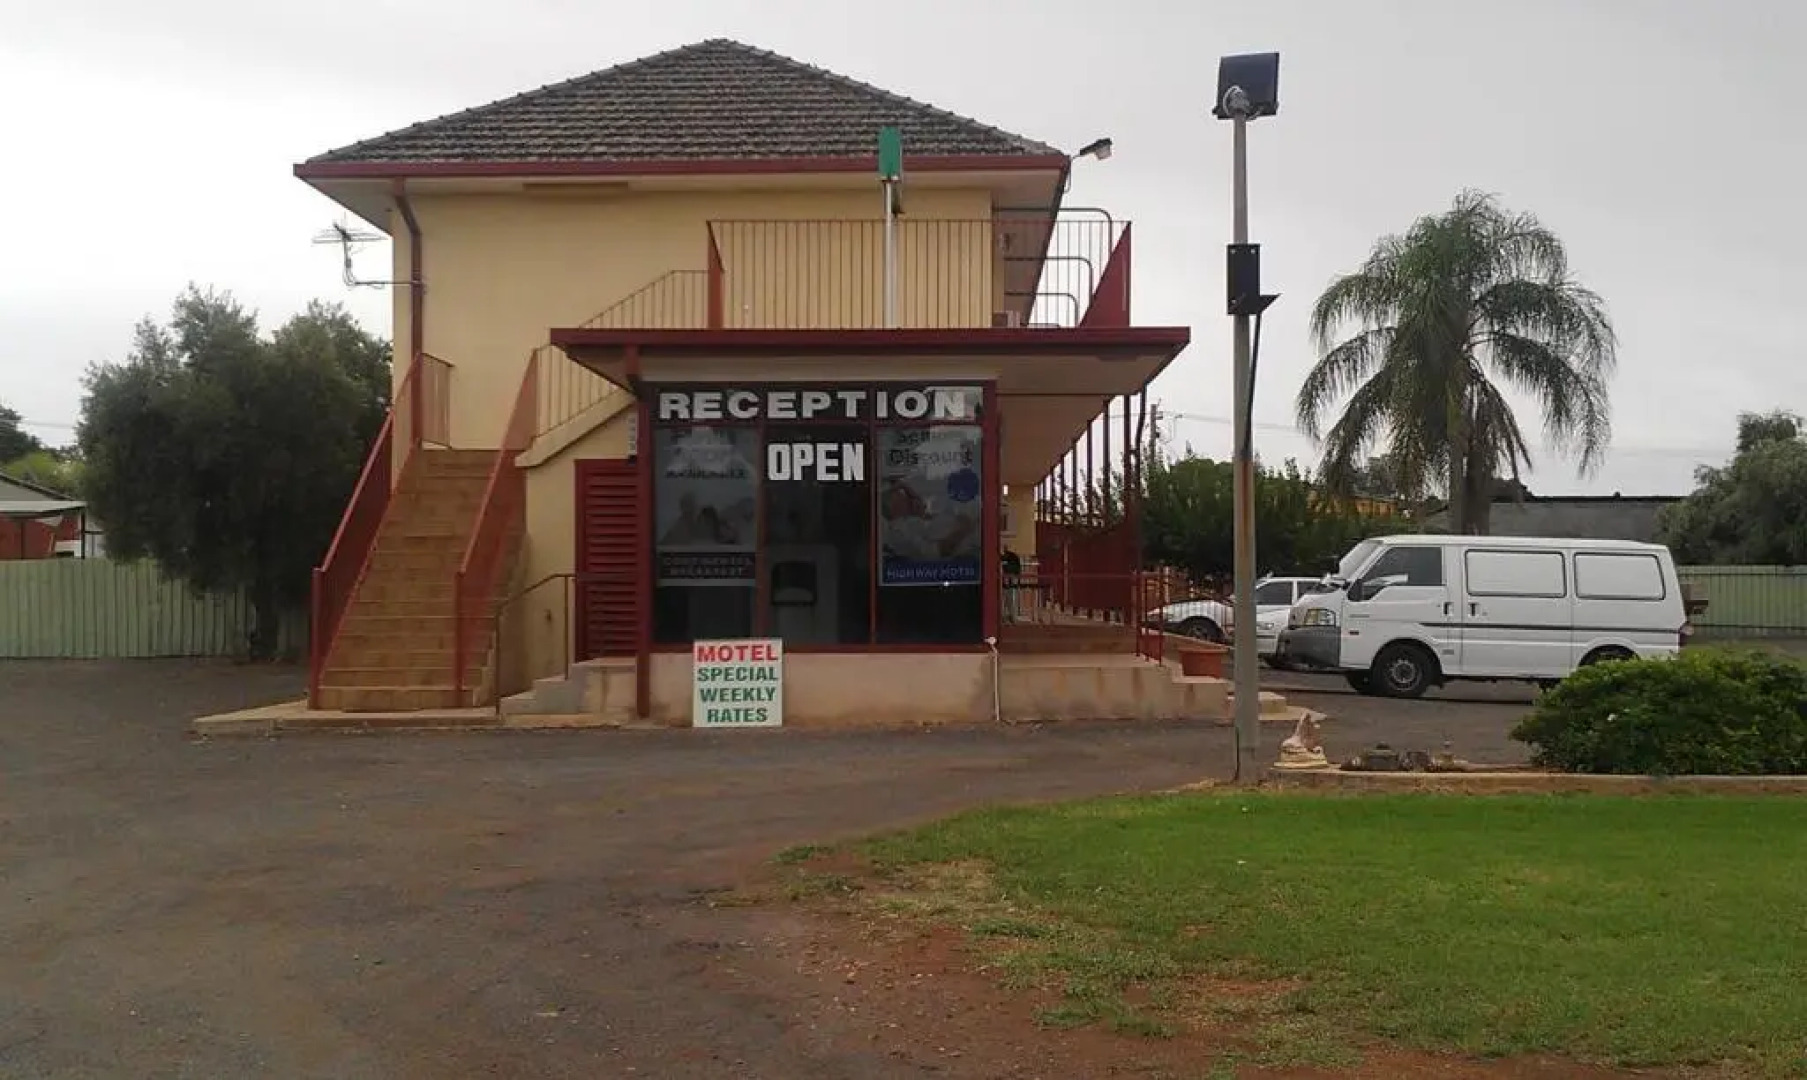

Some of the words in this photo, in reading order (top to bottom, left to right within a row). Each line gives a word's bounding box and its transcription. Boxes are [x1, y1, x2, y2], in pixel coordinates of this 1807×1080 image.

[659, 391, 965, 419] RECEPTION
[767, 442, 865, 481] OPEN
[888, 447, 974, 467] Discount
[697, 645, 778, 662] MOTEL
[697, 667, 778, 682] SPECIAL
[700, 687, 776, 702] WEEKLY
[707, 708, 768, 722] RATES
